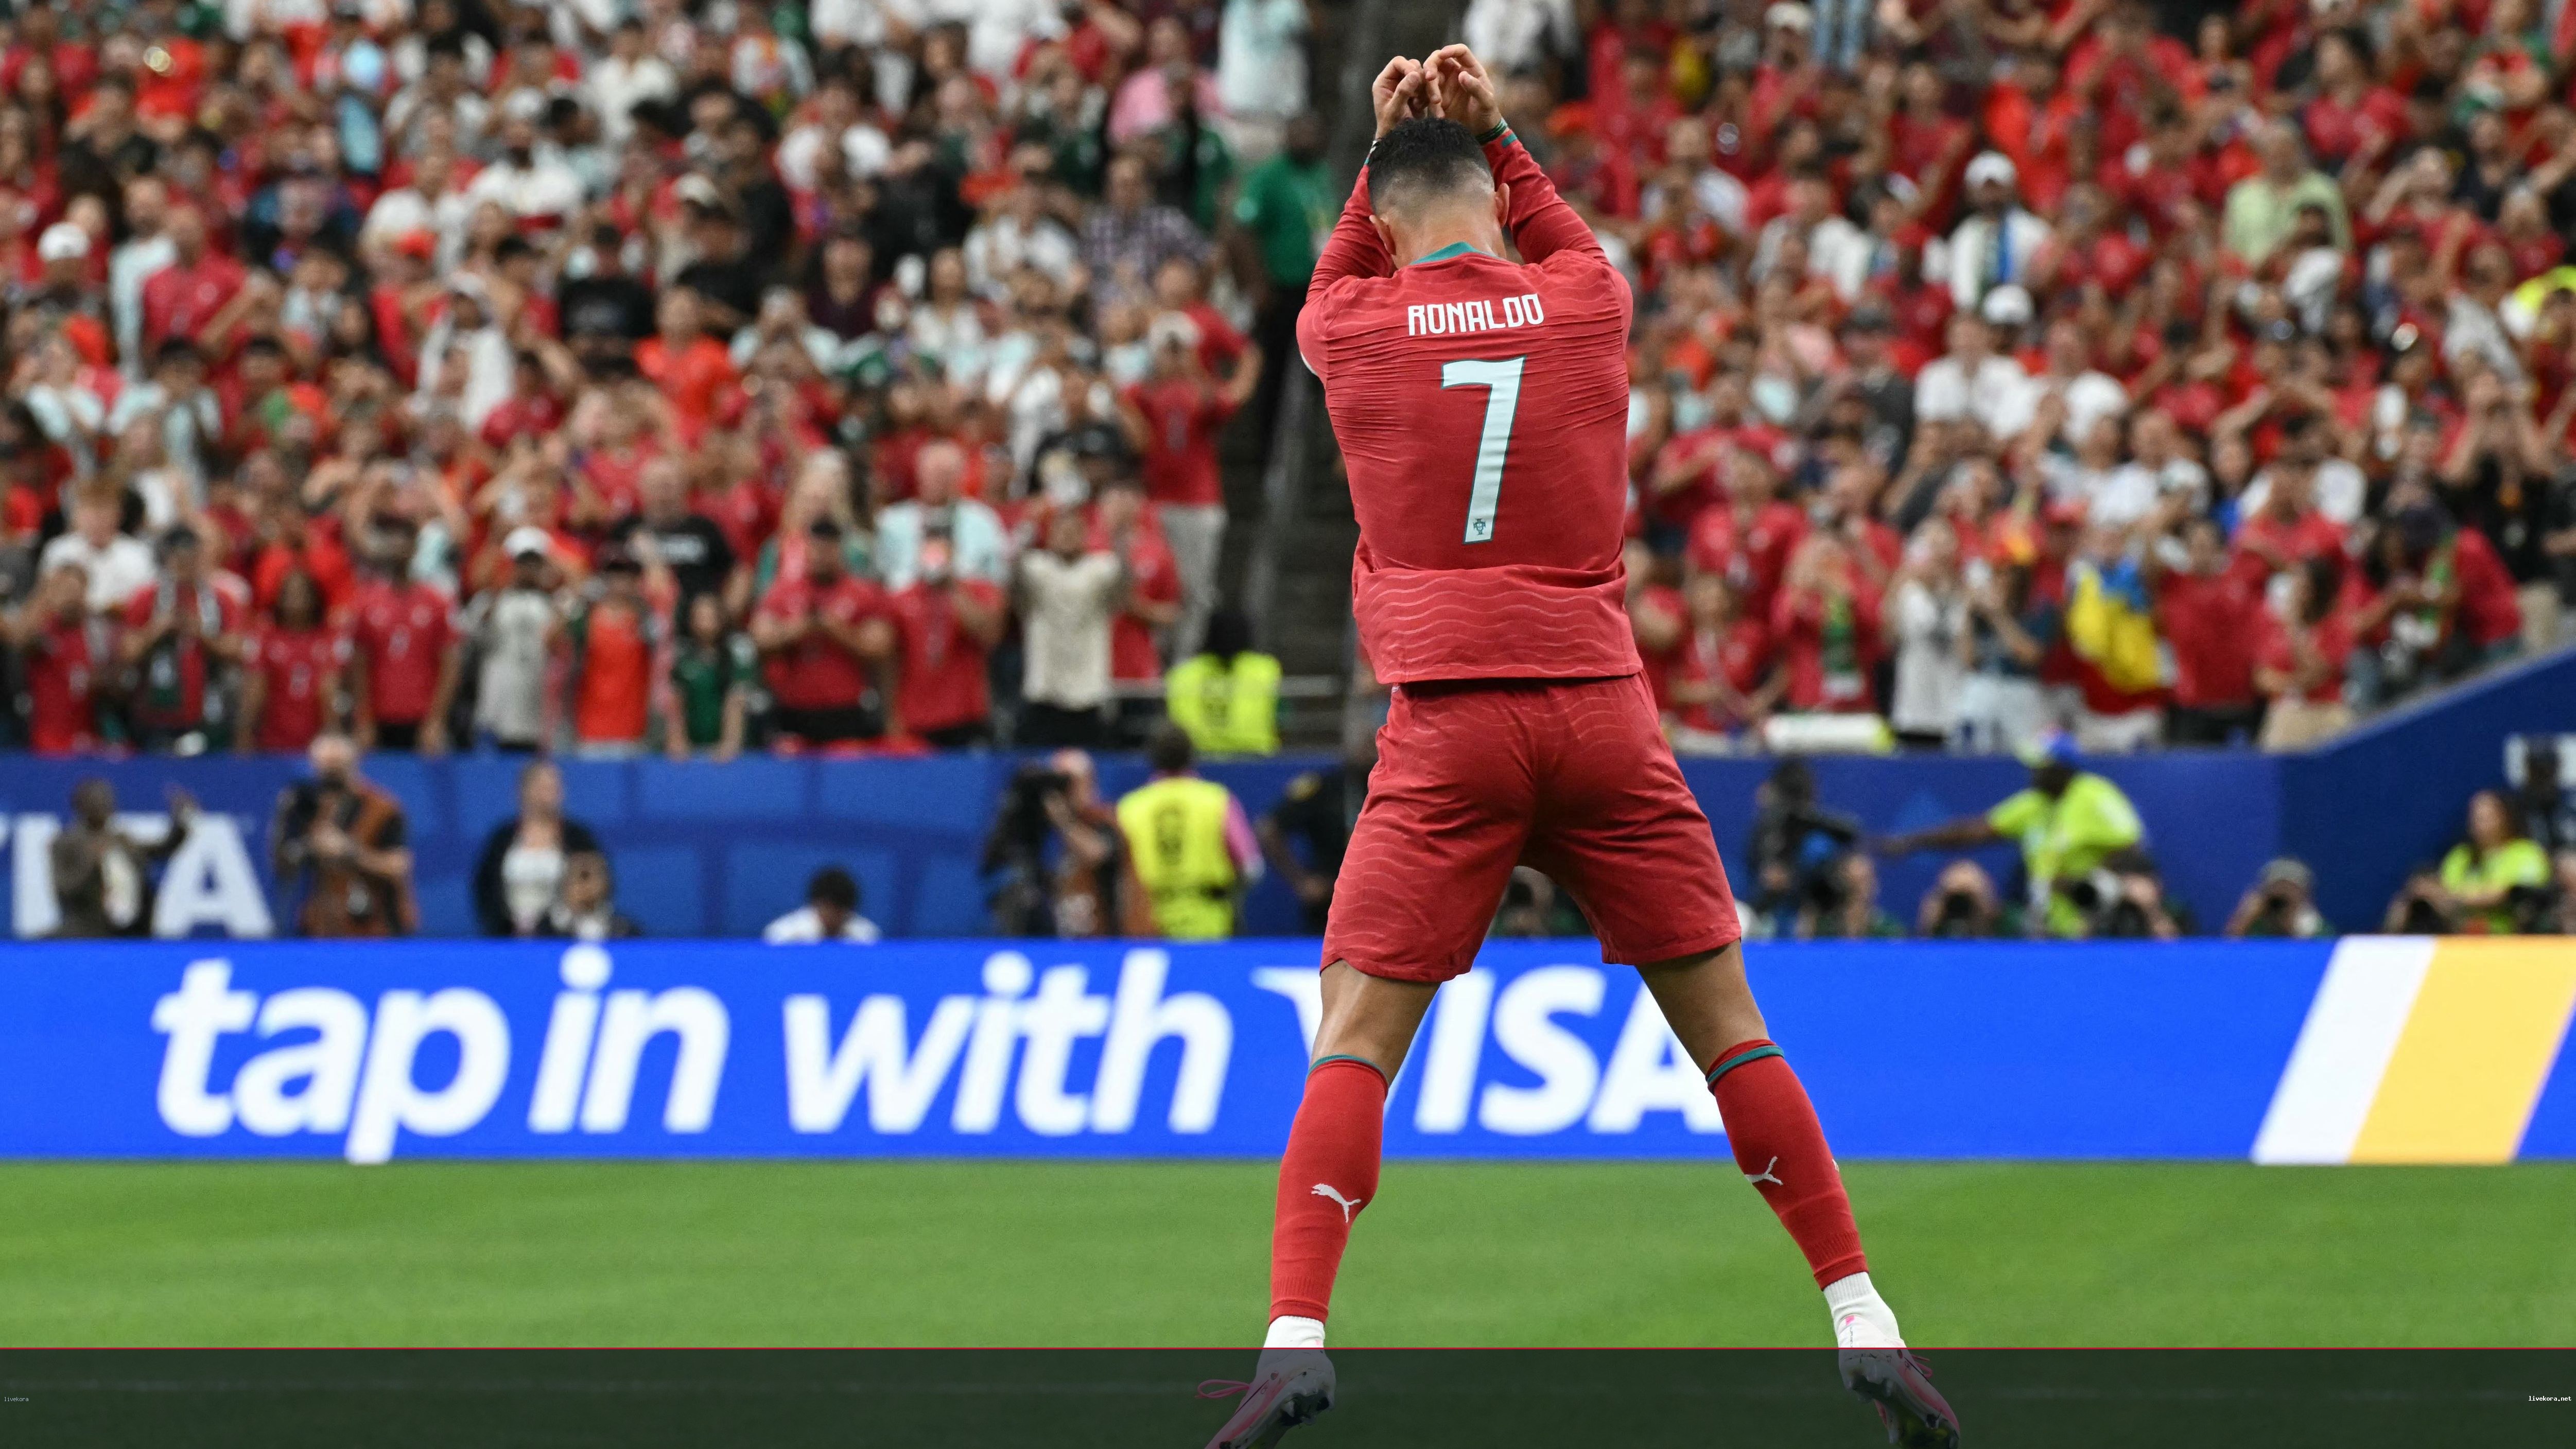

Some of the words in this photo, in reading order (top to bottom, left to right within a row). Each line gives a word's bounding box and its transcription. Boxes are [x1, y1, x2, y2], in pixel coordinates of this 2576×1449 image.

[1407, 293, 1544, 336] RONALDO
[1441, 354, 1527, 545] 7
[150, 957, 512, 1164] tap
[528, 944, 731, 1134] in
[782, 948, 1233, 1136] with
